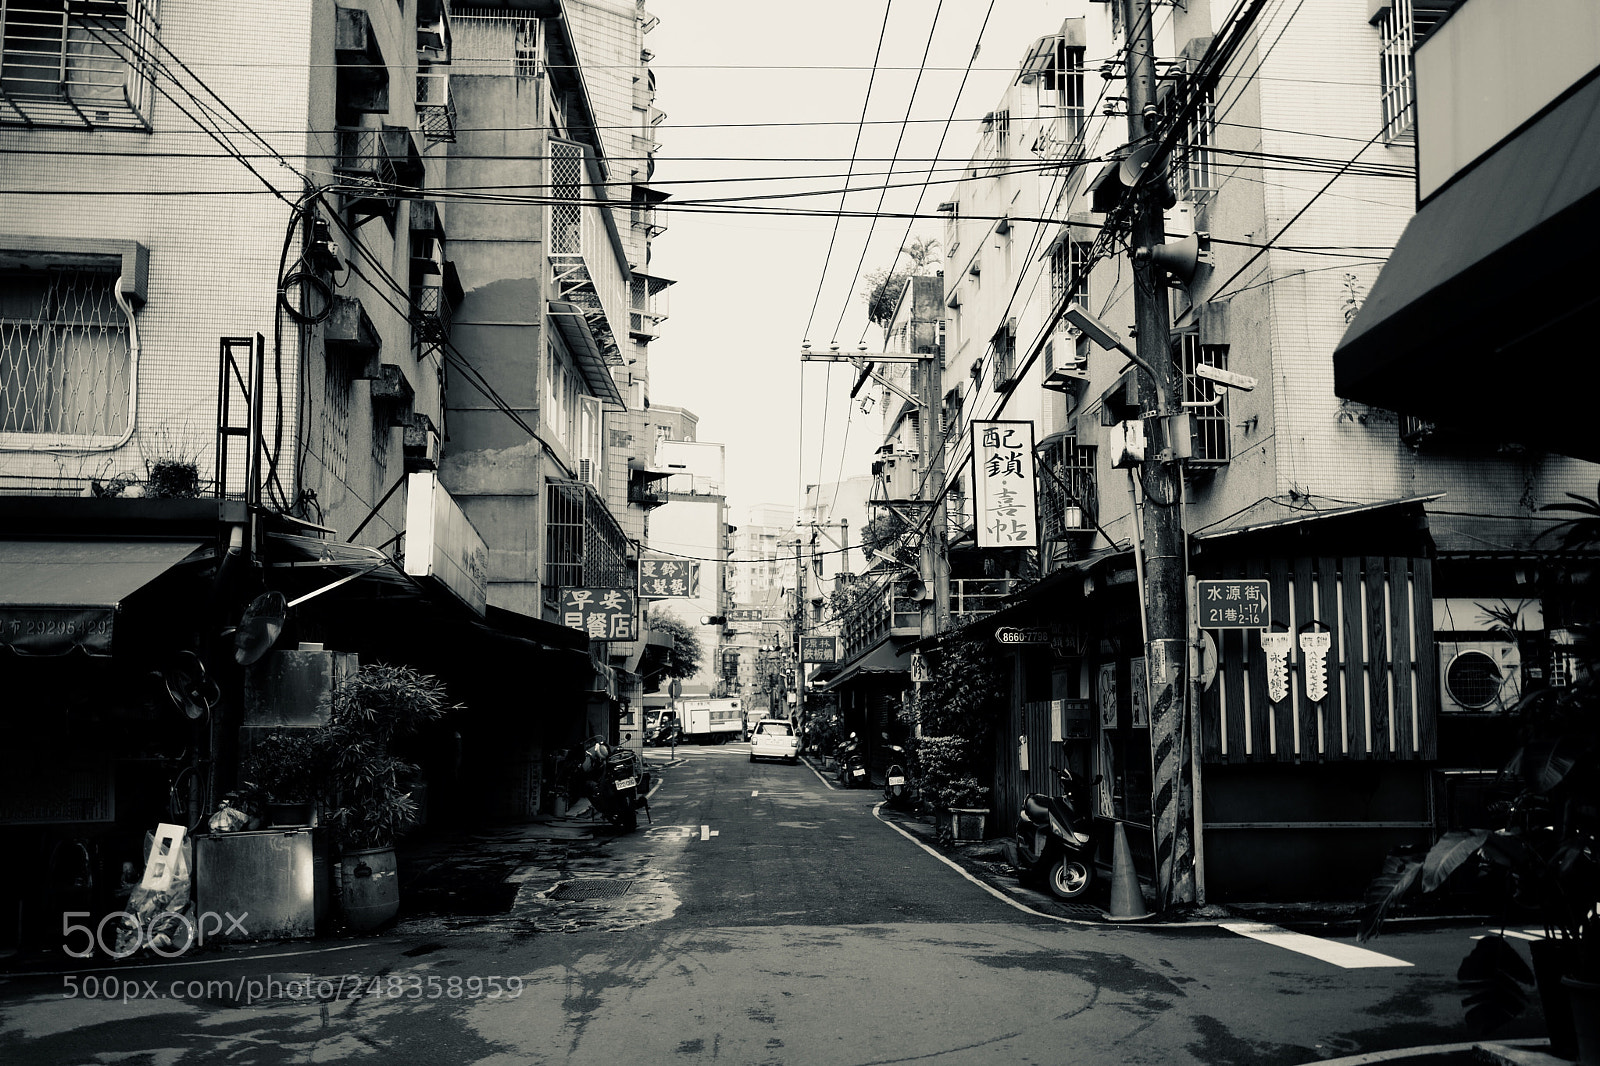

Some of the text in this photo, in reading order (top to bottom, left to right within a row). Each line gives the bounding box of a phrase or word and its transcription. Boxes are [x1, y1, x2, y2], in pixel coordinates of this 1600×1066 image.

[642, 561, 679, 578] 曼鈴
[652, 579, 687, 595] 髮藝
[1207, 585, 1260, 601] 水源街
[566, 590, 627, 611] 早安
[1239, 603, 1259, 614] 1-17
[1209, 608, 1238, 622] 21巷
[1238, 614, 1260, 624] 2-16
[0, 618, 21, 635] 布
[565, 611, 631, 639] 早餐店
[1002, 632, 1048, 642] 8660-7798
